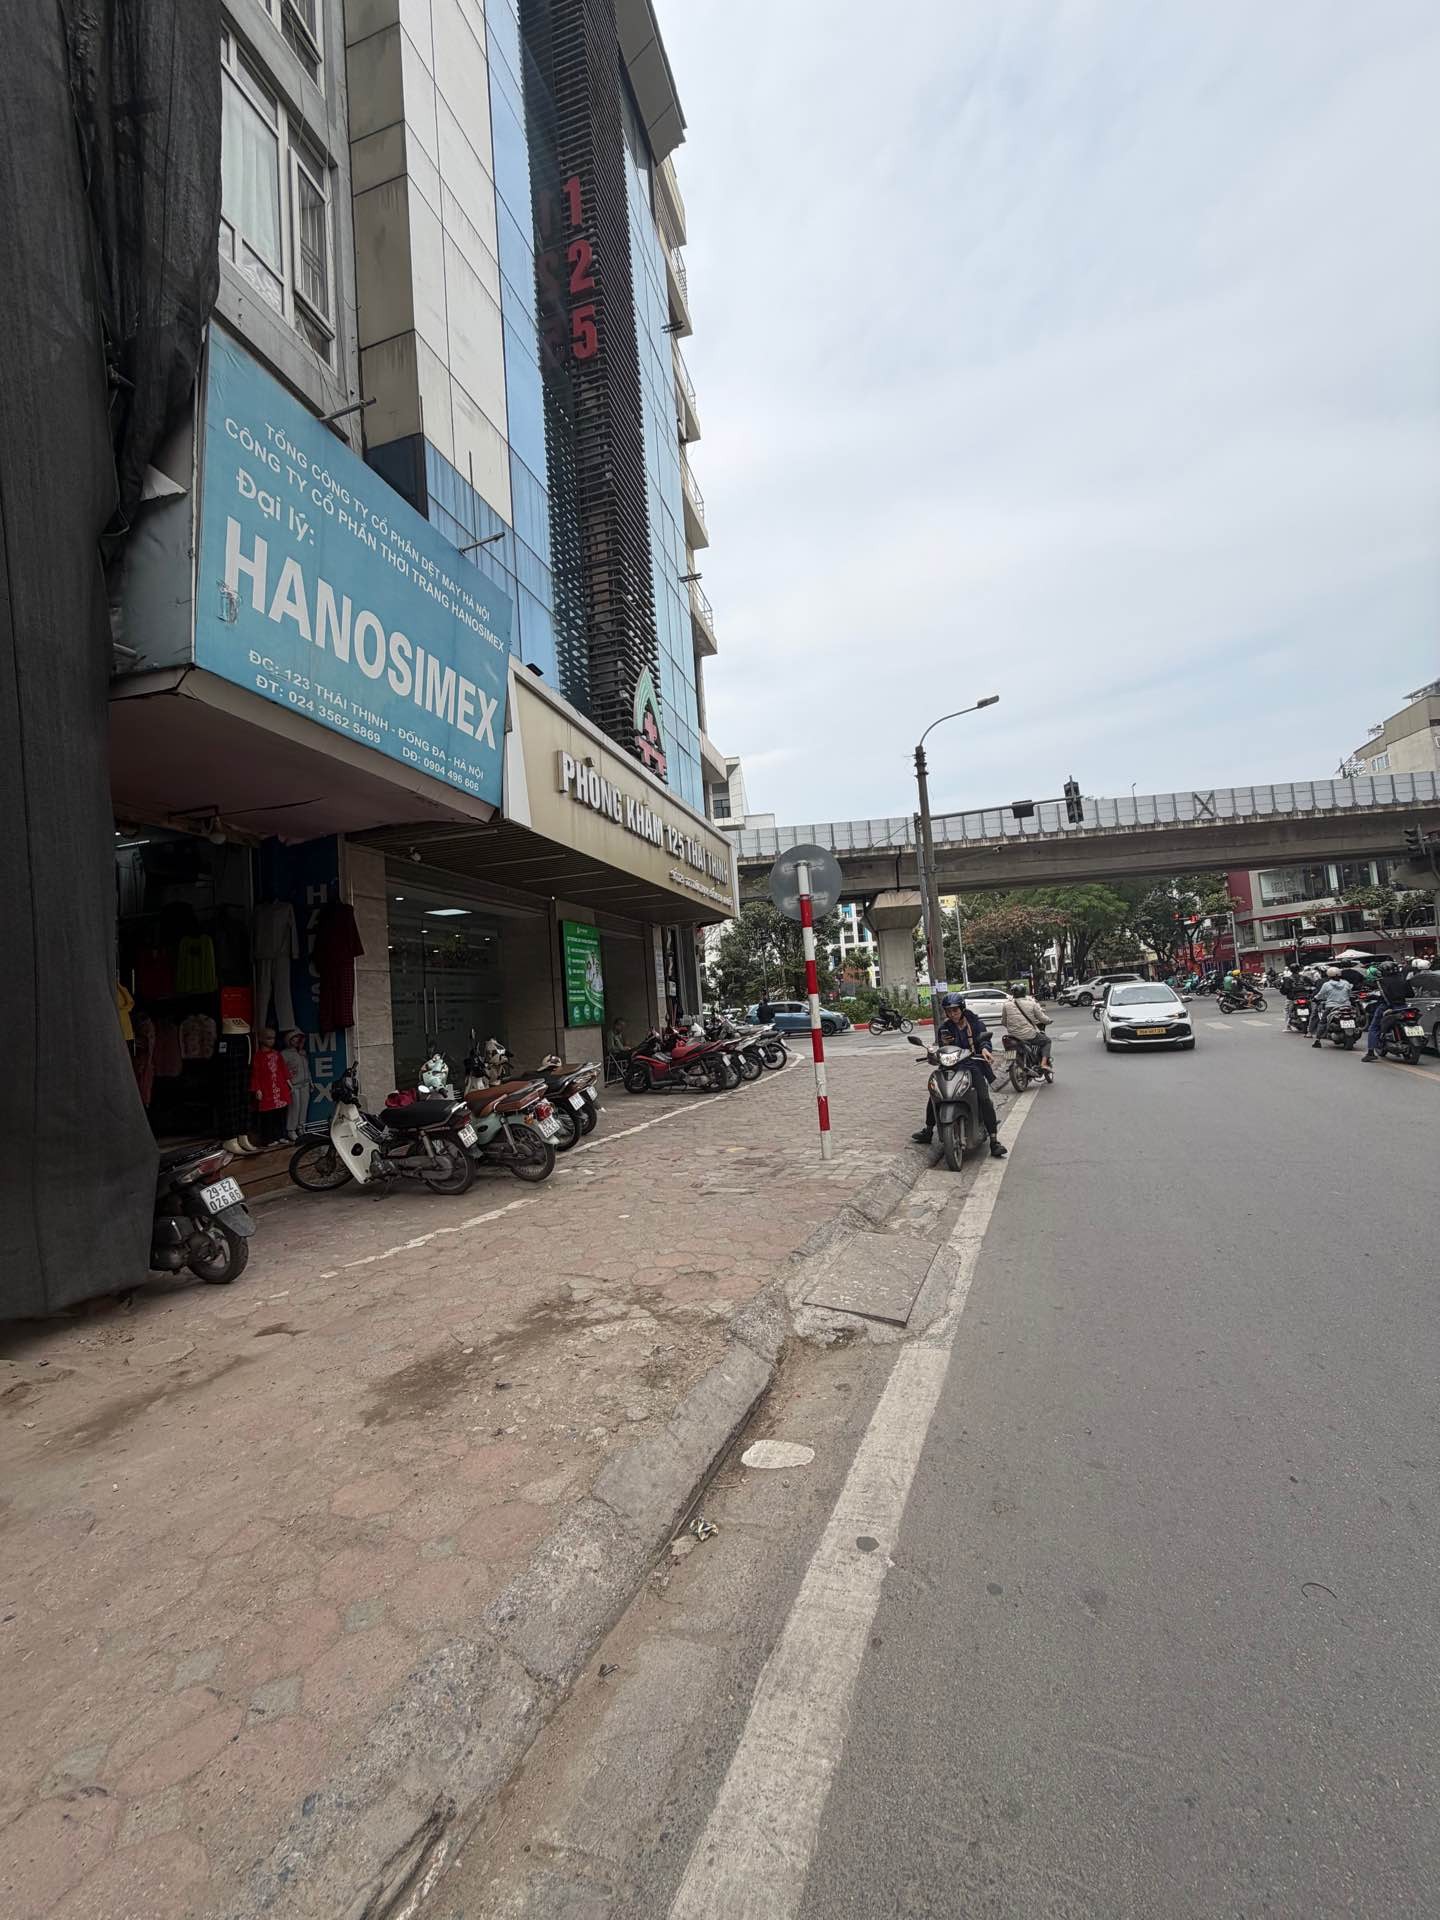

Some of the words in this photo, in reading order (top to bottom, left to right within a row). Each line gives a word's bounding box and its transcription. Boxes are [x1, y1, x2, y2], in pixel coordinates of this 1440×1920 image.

[563, 176, 598, 359] 125
[225, 418, 280, 473] CÔNG
[286, 465, 307, 493] TY
[312, 488, 334, 515] CỔ
[339, 508, 376, 551] PHẦN
[380, 542, 409, 577] THỜI
[412, 568, 449, 608] TRANG
[451, 601, 504, 653] HANOSIMEX
[236, 467, 281, 521] Đại
[289, 505, 315, 546] lý:
[265, 422, 307, 469] TỔNG
[312, 464, 350, 504] CÔNG
[353, 498, 369, 519] TY
[371, 515, 388, 536] CỔ
[391, 530, 419, 562] PHẦN
[421, 556, 440, 579] DỆT
[442, 574, 462, 597] MAY
[463, 591, 475, 610] HÀ
[477, 604, 490, 622] NỘI
[224, 515, 499, 750] HANOSIMEX
[255, 674, 284, 697] ĐT:
[288, 691, 315, 712] 024
[318, 705, 350, 729] 3562
[352, 724, 381, 744] 5869
[402, 746, 421, 764] DĐ:
[423, 757, 446, 775] 0904
[284, 669, 310, 690] 123
[314, 682, 348, 710] THÁI
[350, 702, 388, 731] THỊNH
[398, 727, 430, 752] ĐỐNG
[432, 745, 446, 761] ĐA
[453, 756, 467, 771] HÀ
[468, 765, 484, 780] NỘI
[557, 751, 623, 824] PHÒNG
[624, 794, 664, 848] KHÁM
[665, 823, 685, 860] 125
